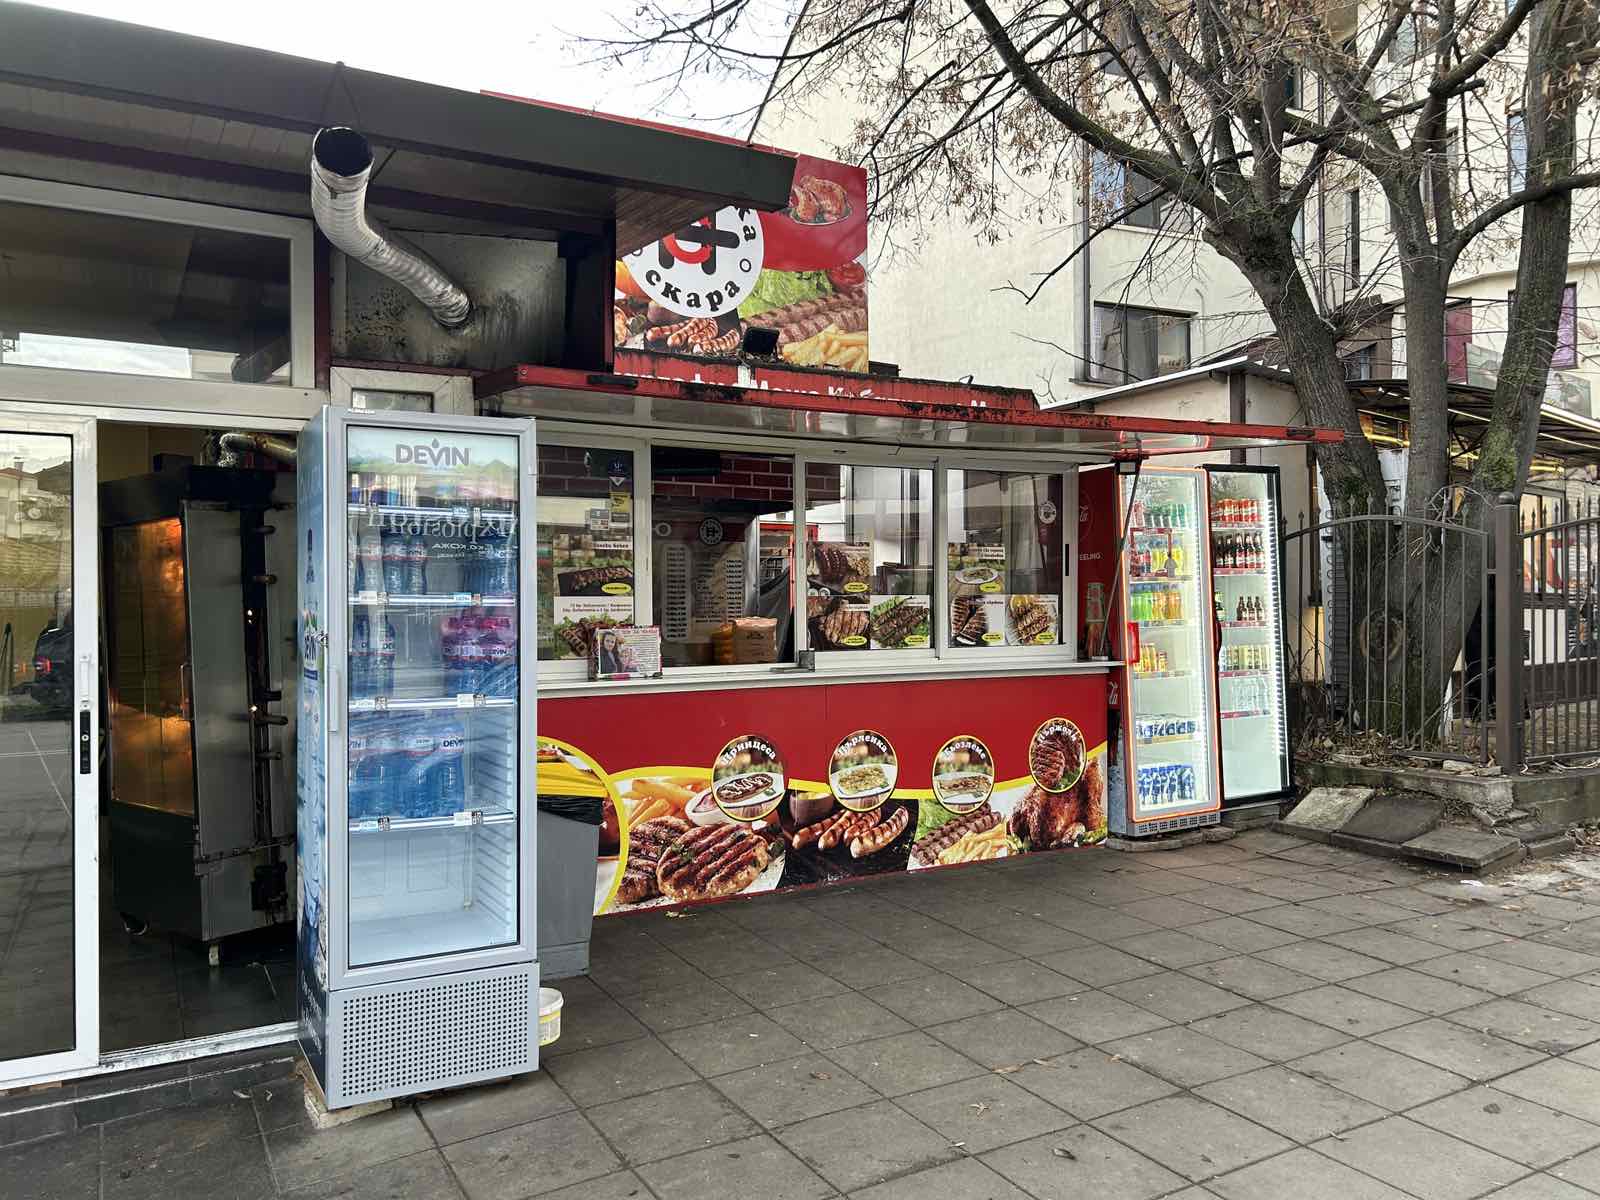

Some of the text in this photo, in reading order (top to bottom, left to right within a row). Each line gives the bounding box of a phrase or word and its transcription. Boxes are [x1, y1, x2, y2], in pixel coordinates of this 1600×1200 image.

[645, 269, 741, 312] скара
[395, 443, 471, 467] DEVIN
[720, 740, 777, 766] Принцеса
